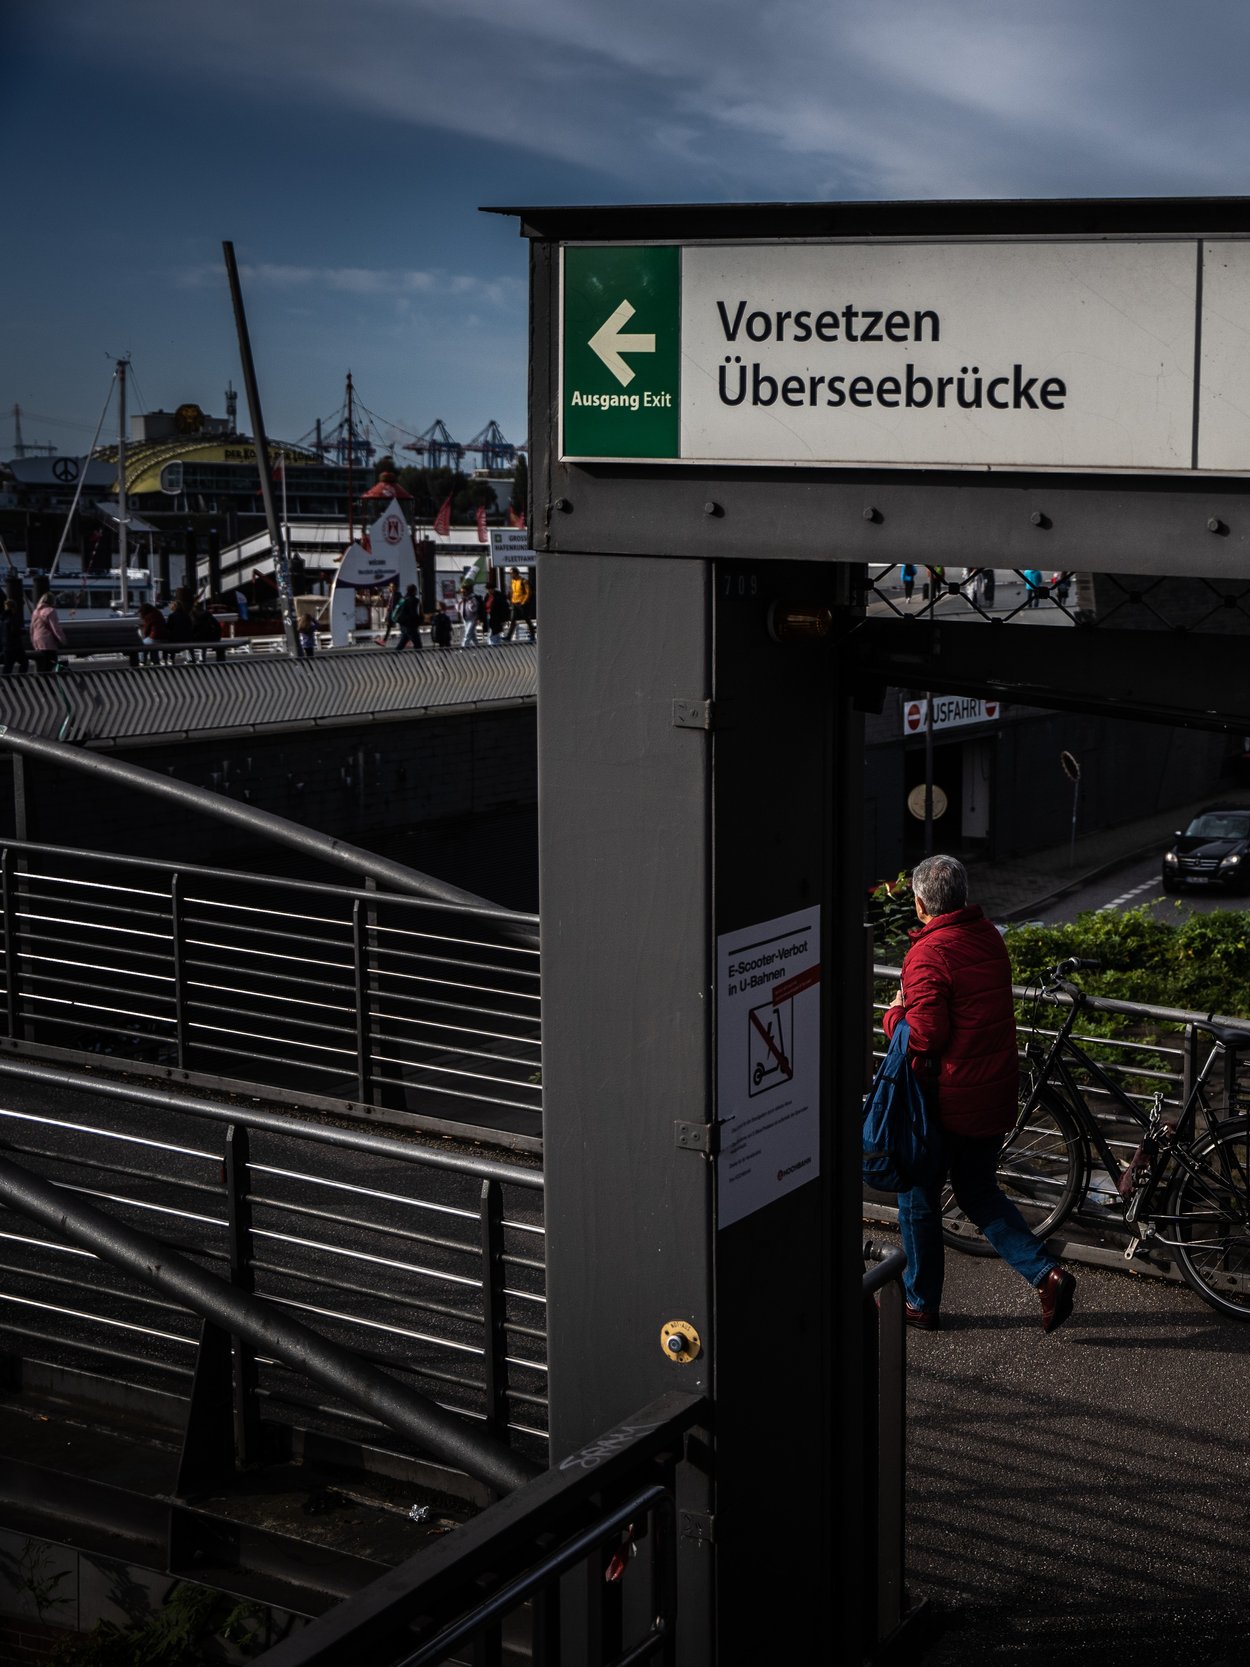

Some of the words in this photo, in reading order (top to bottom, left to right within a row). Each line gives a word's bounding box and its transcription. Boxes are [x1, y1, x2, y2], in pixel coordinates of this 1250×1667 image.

[716, 300, 940, 343] Vorsetzen
[718, 356, 1067, 411] Überseebrücke
[571, 390, 640, 411] Ausgang
[642, 391, 672, 408] Exit
[923, 698, 981, 726] USFAHR
[728, 940, 808, 978] E-Scooter-Verbot
[728, 984, 737, 997] in
[740, 968, 786, 992] U-Bahnen
